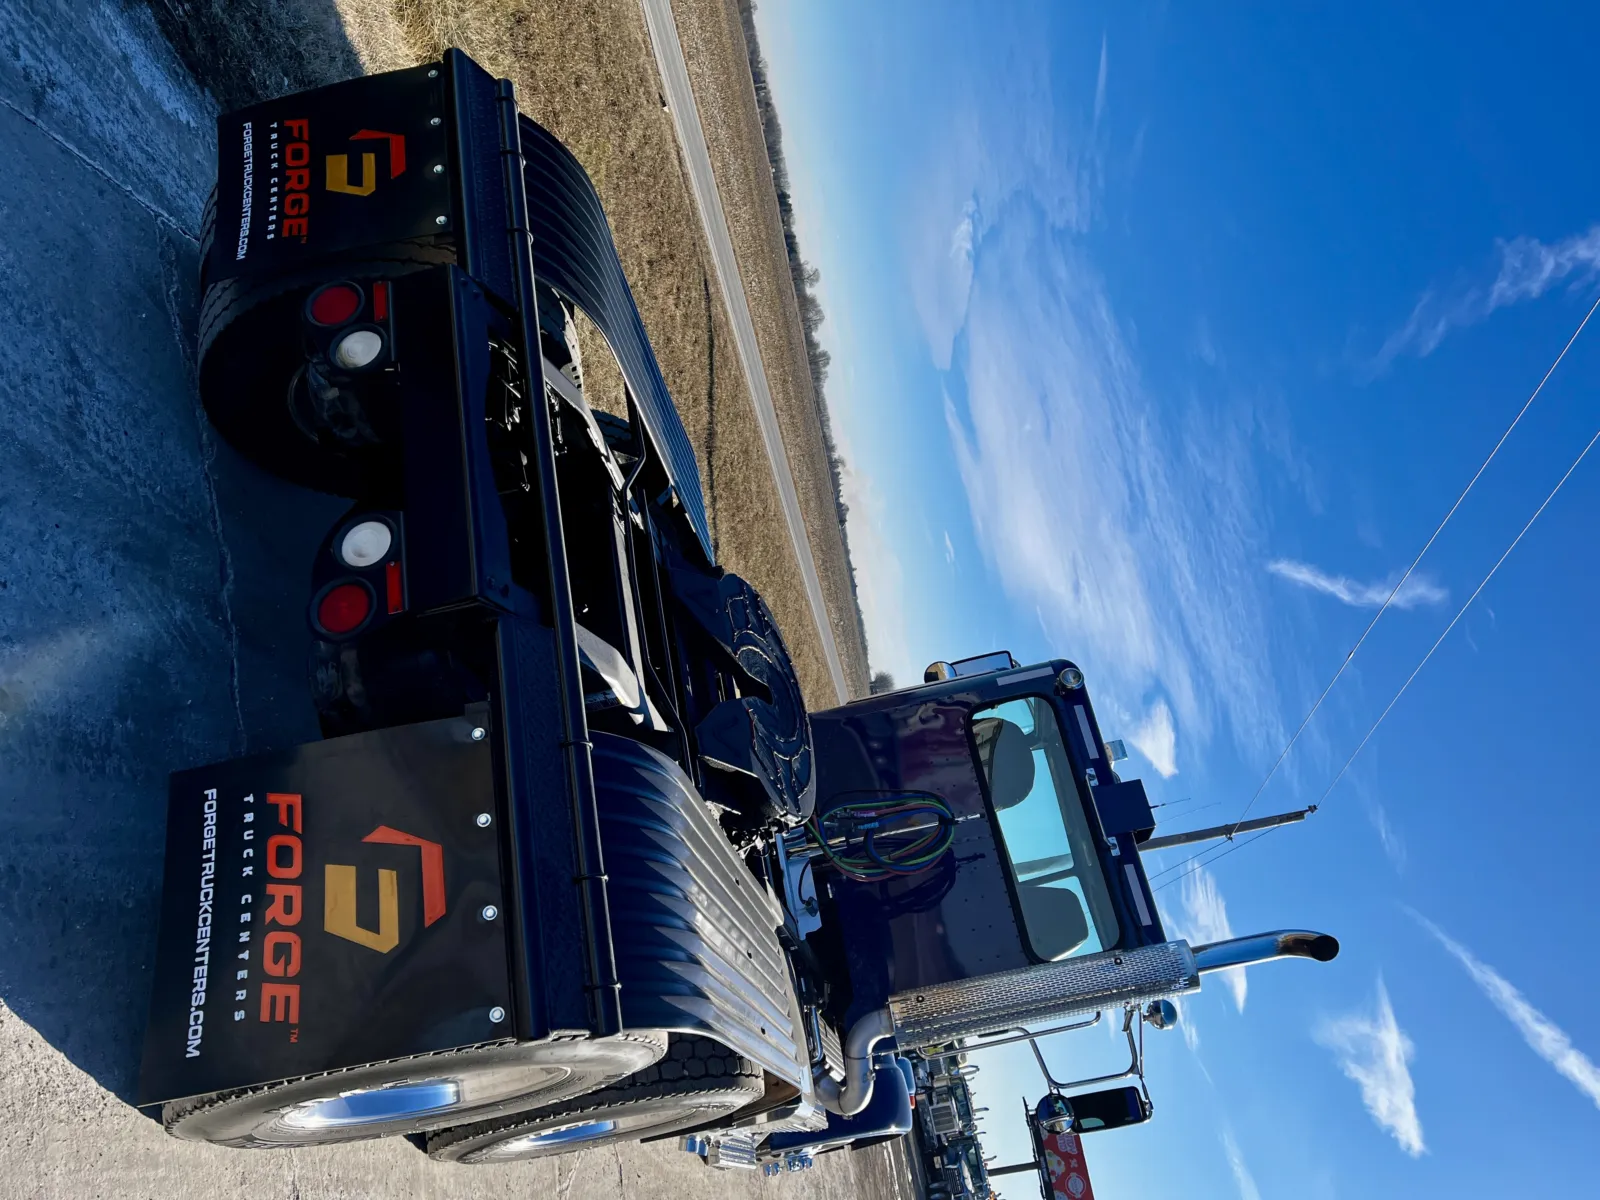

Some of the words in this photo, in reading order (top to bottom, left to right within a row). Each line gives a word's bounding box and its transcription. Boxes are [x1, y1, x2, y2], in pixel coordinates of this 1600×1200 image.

[236, 121, 253, 260] FORGETRUCKCENTERS.COM
[269, 121, 279, 169] TRUCK
[282, 118, 310, 237] FORGE
[266, 177, 279, 240] CENTERS
[242, 793, 254, 877] TRUCK
[185, 788, 217, 1058] FORGETRUCKCENTERS.COM
[234, 894, 252, 1021] CENTERS
[260, 792, 303, 1024] FORGE
